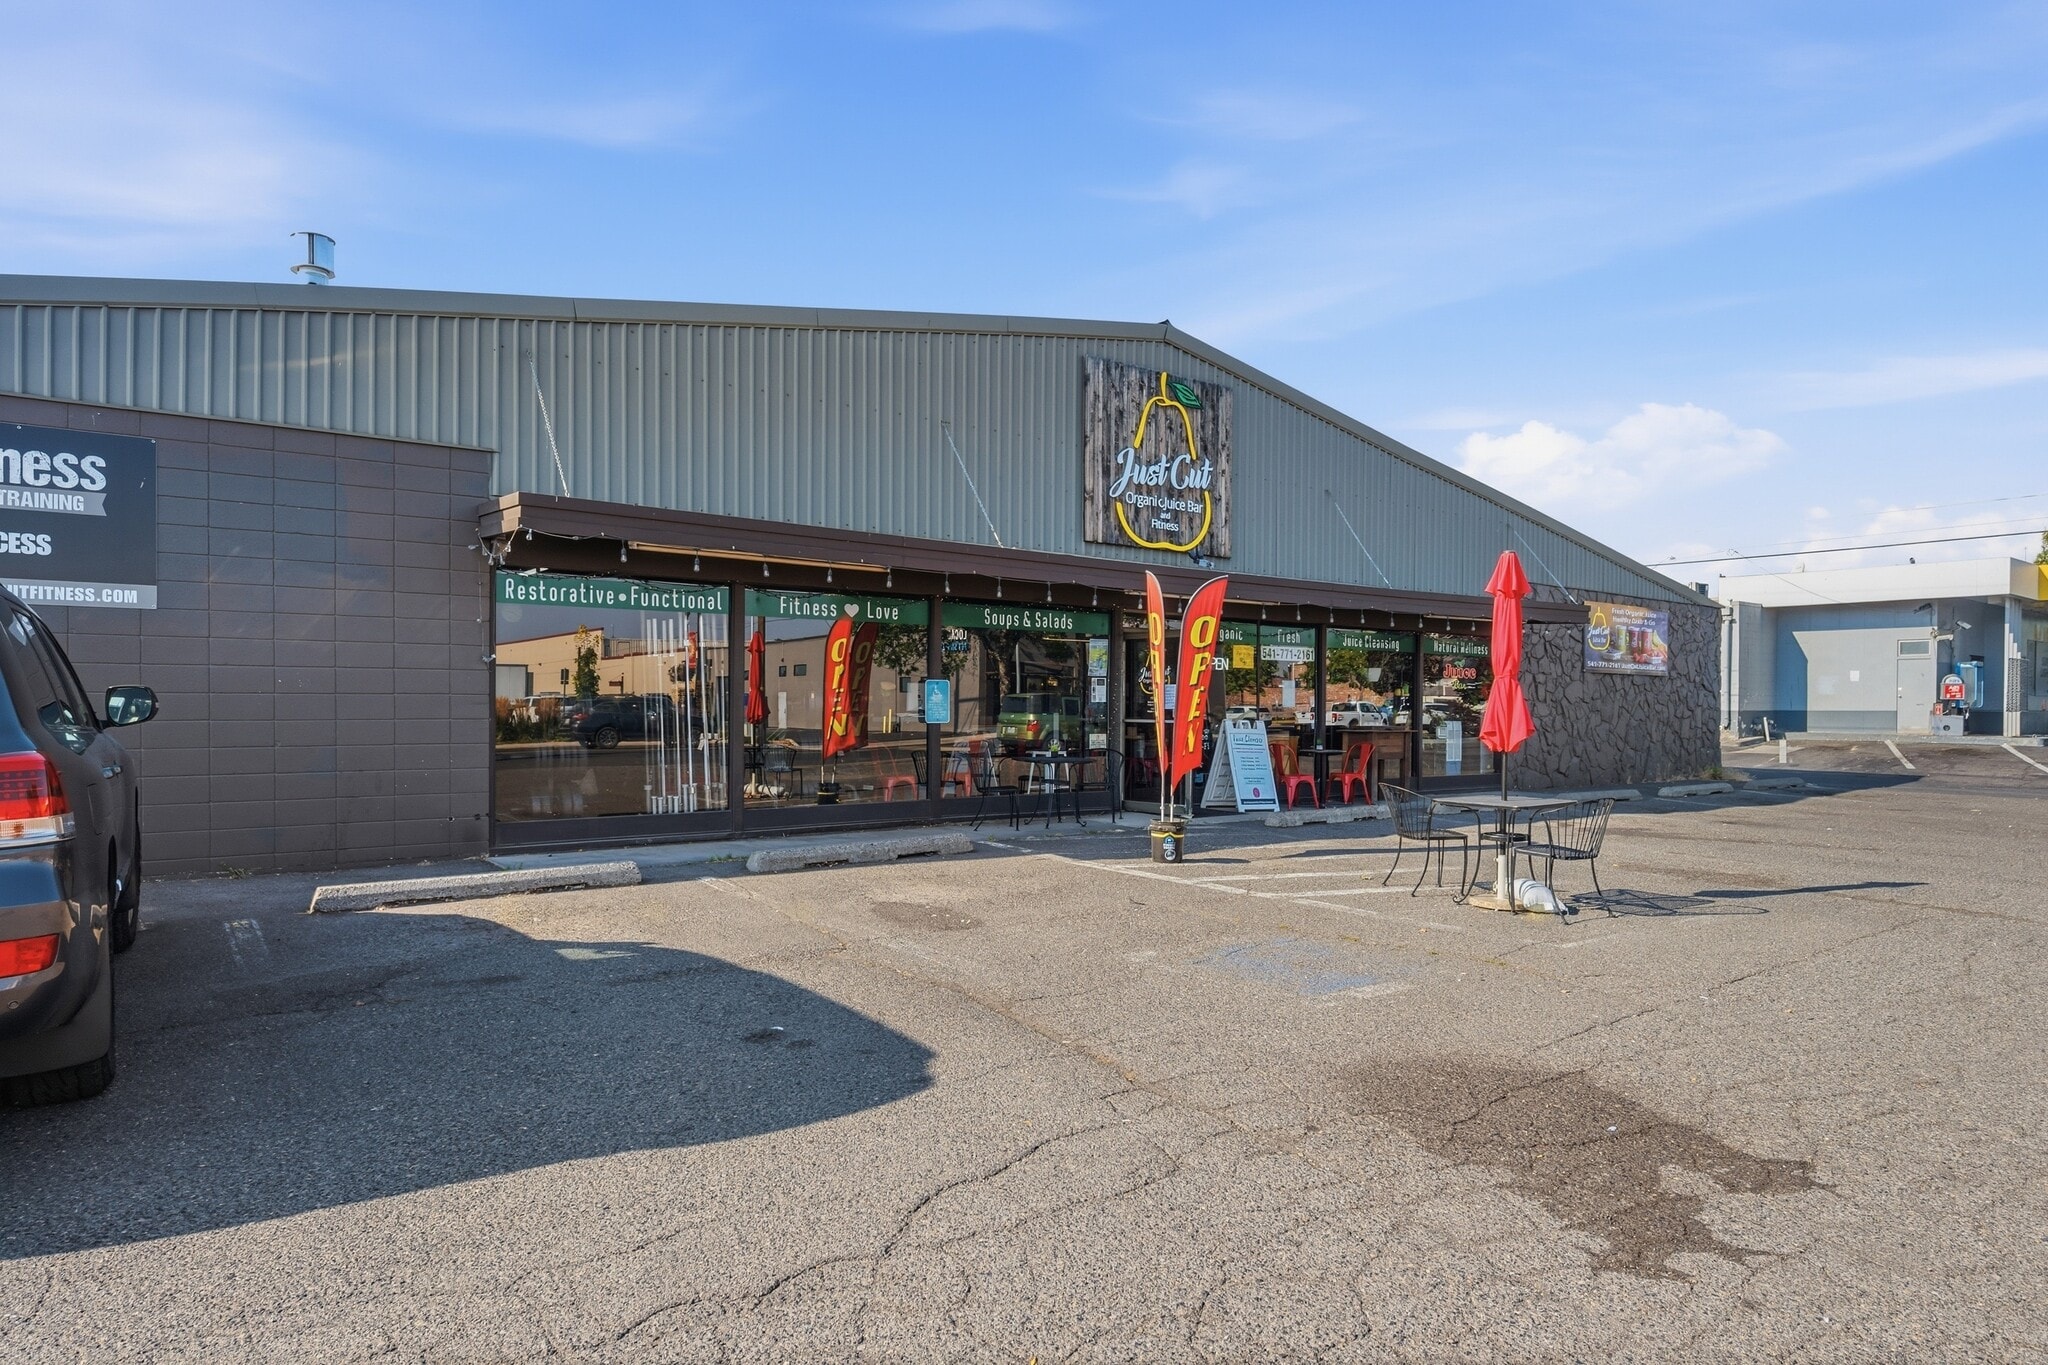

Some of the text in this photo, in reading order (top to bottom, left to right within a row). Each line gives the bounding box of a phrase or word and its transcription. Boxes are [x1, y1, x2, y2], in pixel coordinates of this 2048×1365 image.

[1109, 447, 1213, 498] Just Cut
[1125, 491, 1204, 514] Organic Juice Bar
[1160, 511, 1171, 520] and
[1151, 518, 1179, 532] Fitness
[505, 578, 722, 611] Restorative Functional
[779, 596, 899, 620] Fitness Love
[984, 608, 1073, 630] Soups & Salads
[1219, 627, 1243, 642] ganic
[1277, 628, 1301, 644] Fresh
[1342, 634, 1400, 652] Juice Cleansing
[1262, 647, 1314, 661] 541-771-2161
[1433, 640, 1459, 654] Natural
[1211, 656, 1229, 670] PEN
[1182, 615, 1217, 756] OPEN
